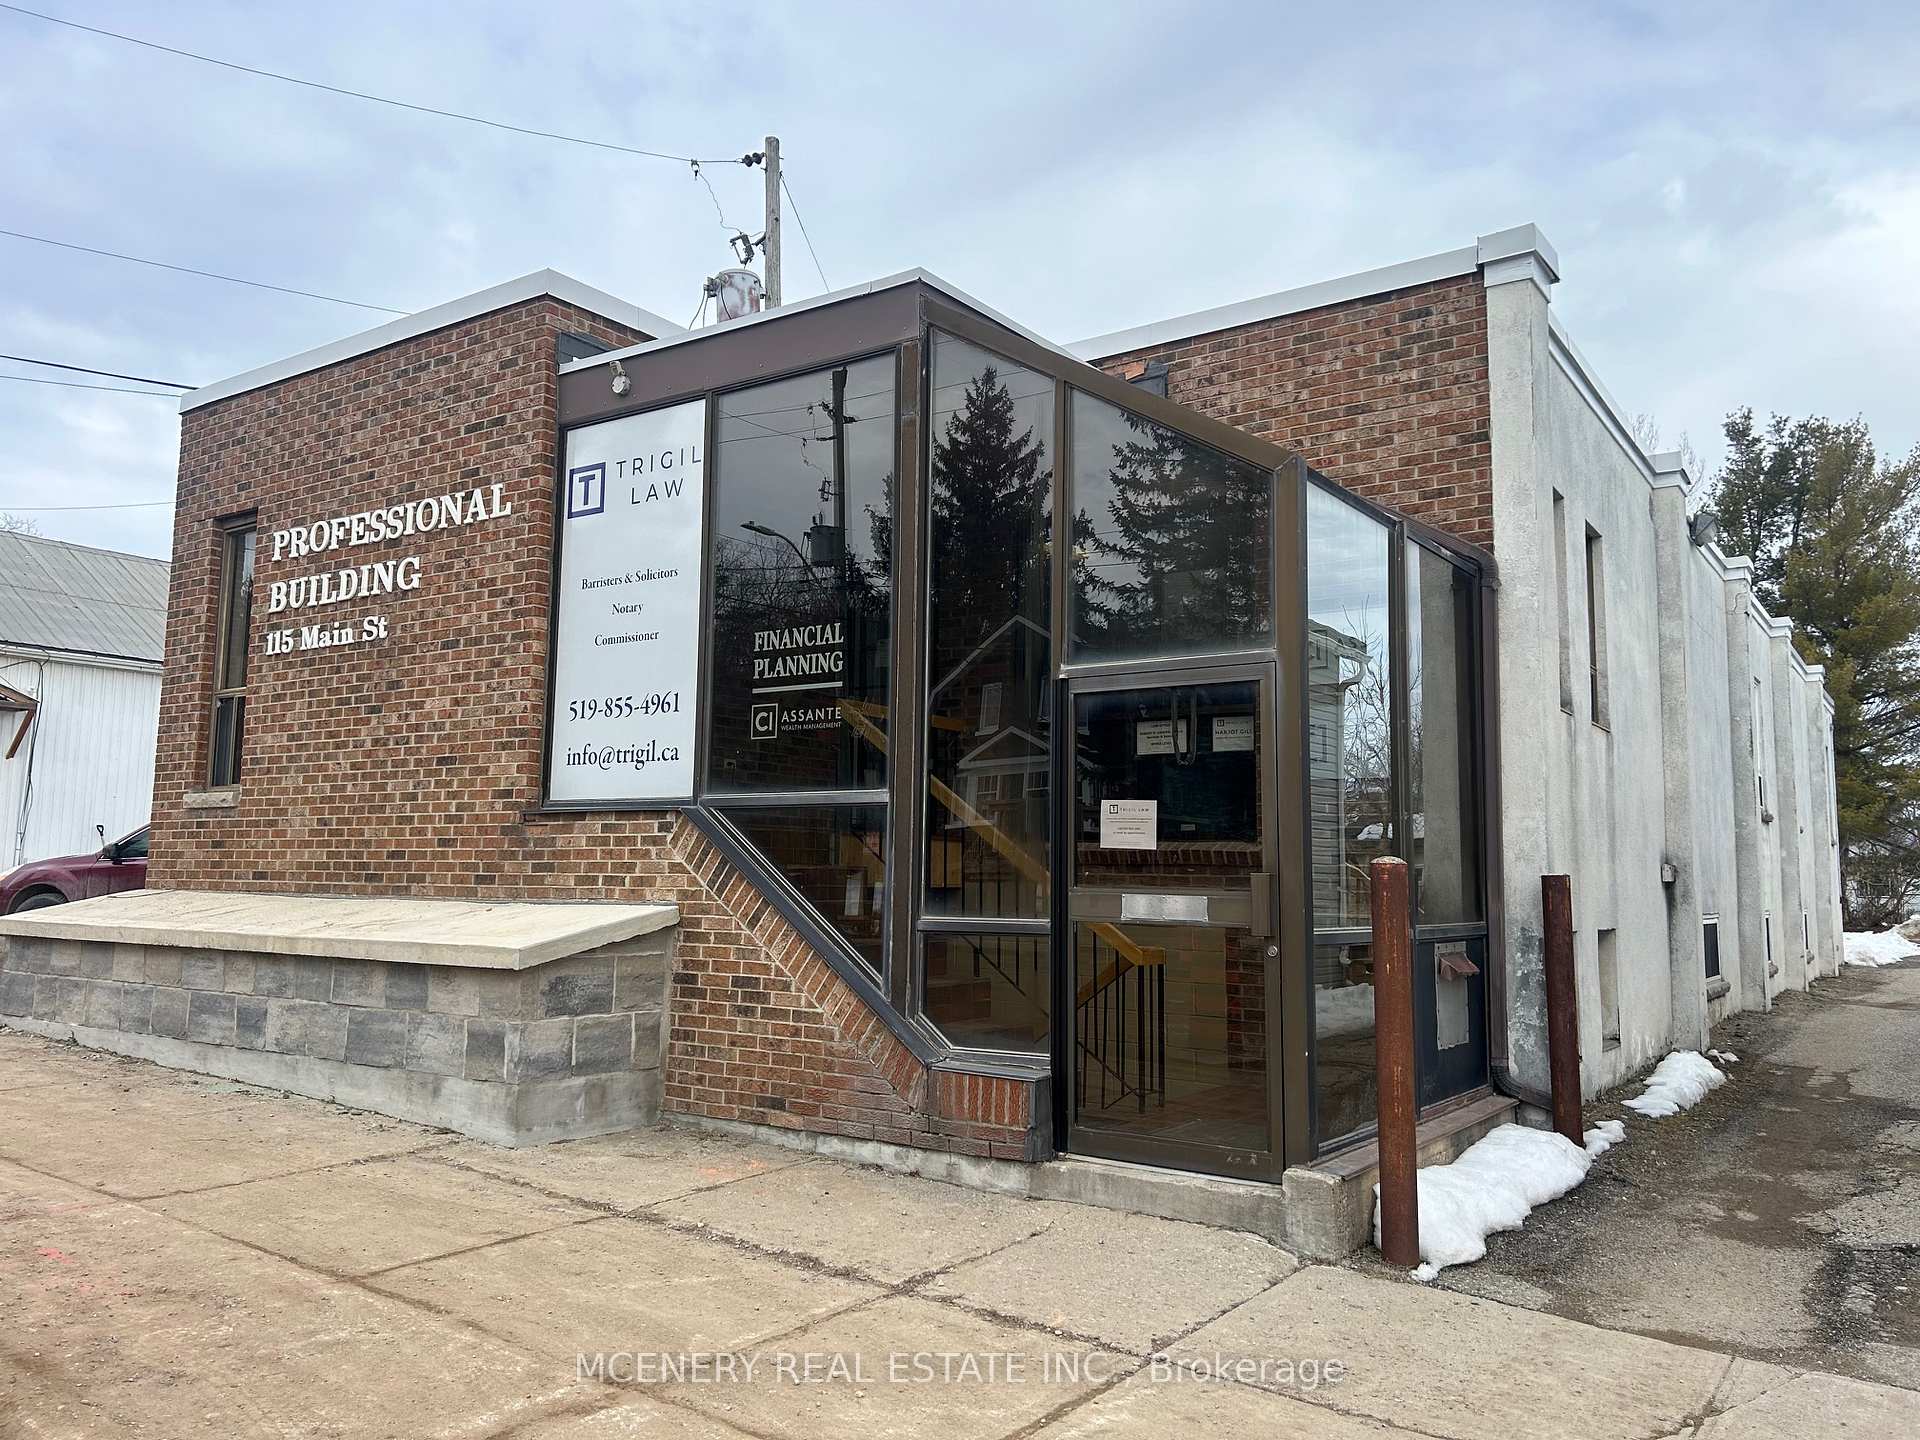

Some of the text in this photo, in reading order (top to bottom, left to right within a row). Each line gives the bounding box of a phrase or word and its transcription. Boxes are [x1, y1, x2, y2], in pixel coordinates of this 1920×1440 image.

[615, 445, 702, 479] TRIGIL
[631, 478, 684, 505] LAW
[271, 483, 512, 562] PROFESSIONAL
[268, 556, 422, 614] BUILDING
[581, 568, 679, 590] Barristers & Solicitors
[611, 602, 644, 616] Notary
[265, 616, 388, 656] 115 Main St
[594, 630, 660, 647] Commissioner
[753, 622, 844, 652] FINANCIAL
[753, 651, 844, 679] PLANNING
[569, 690, 681, 722] 519-855-4961
[781, 706, 842, 723] ASSANTE
[803, 721, 841, 730] MANAGEMENT
[566, 740, 680, 770] info@trigil.ca
